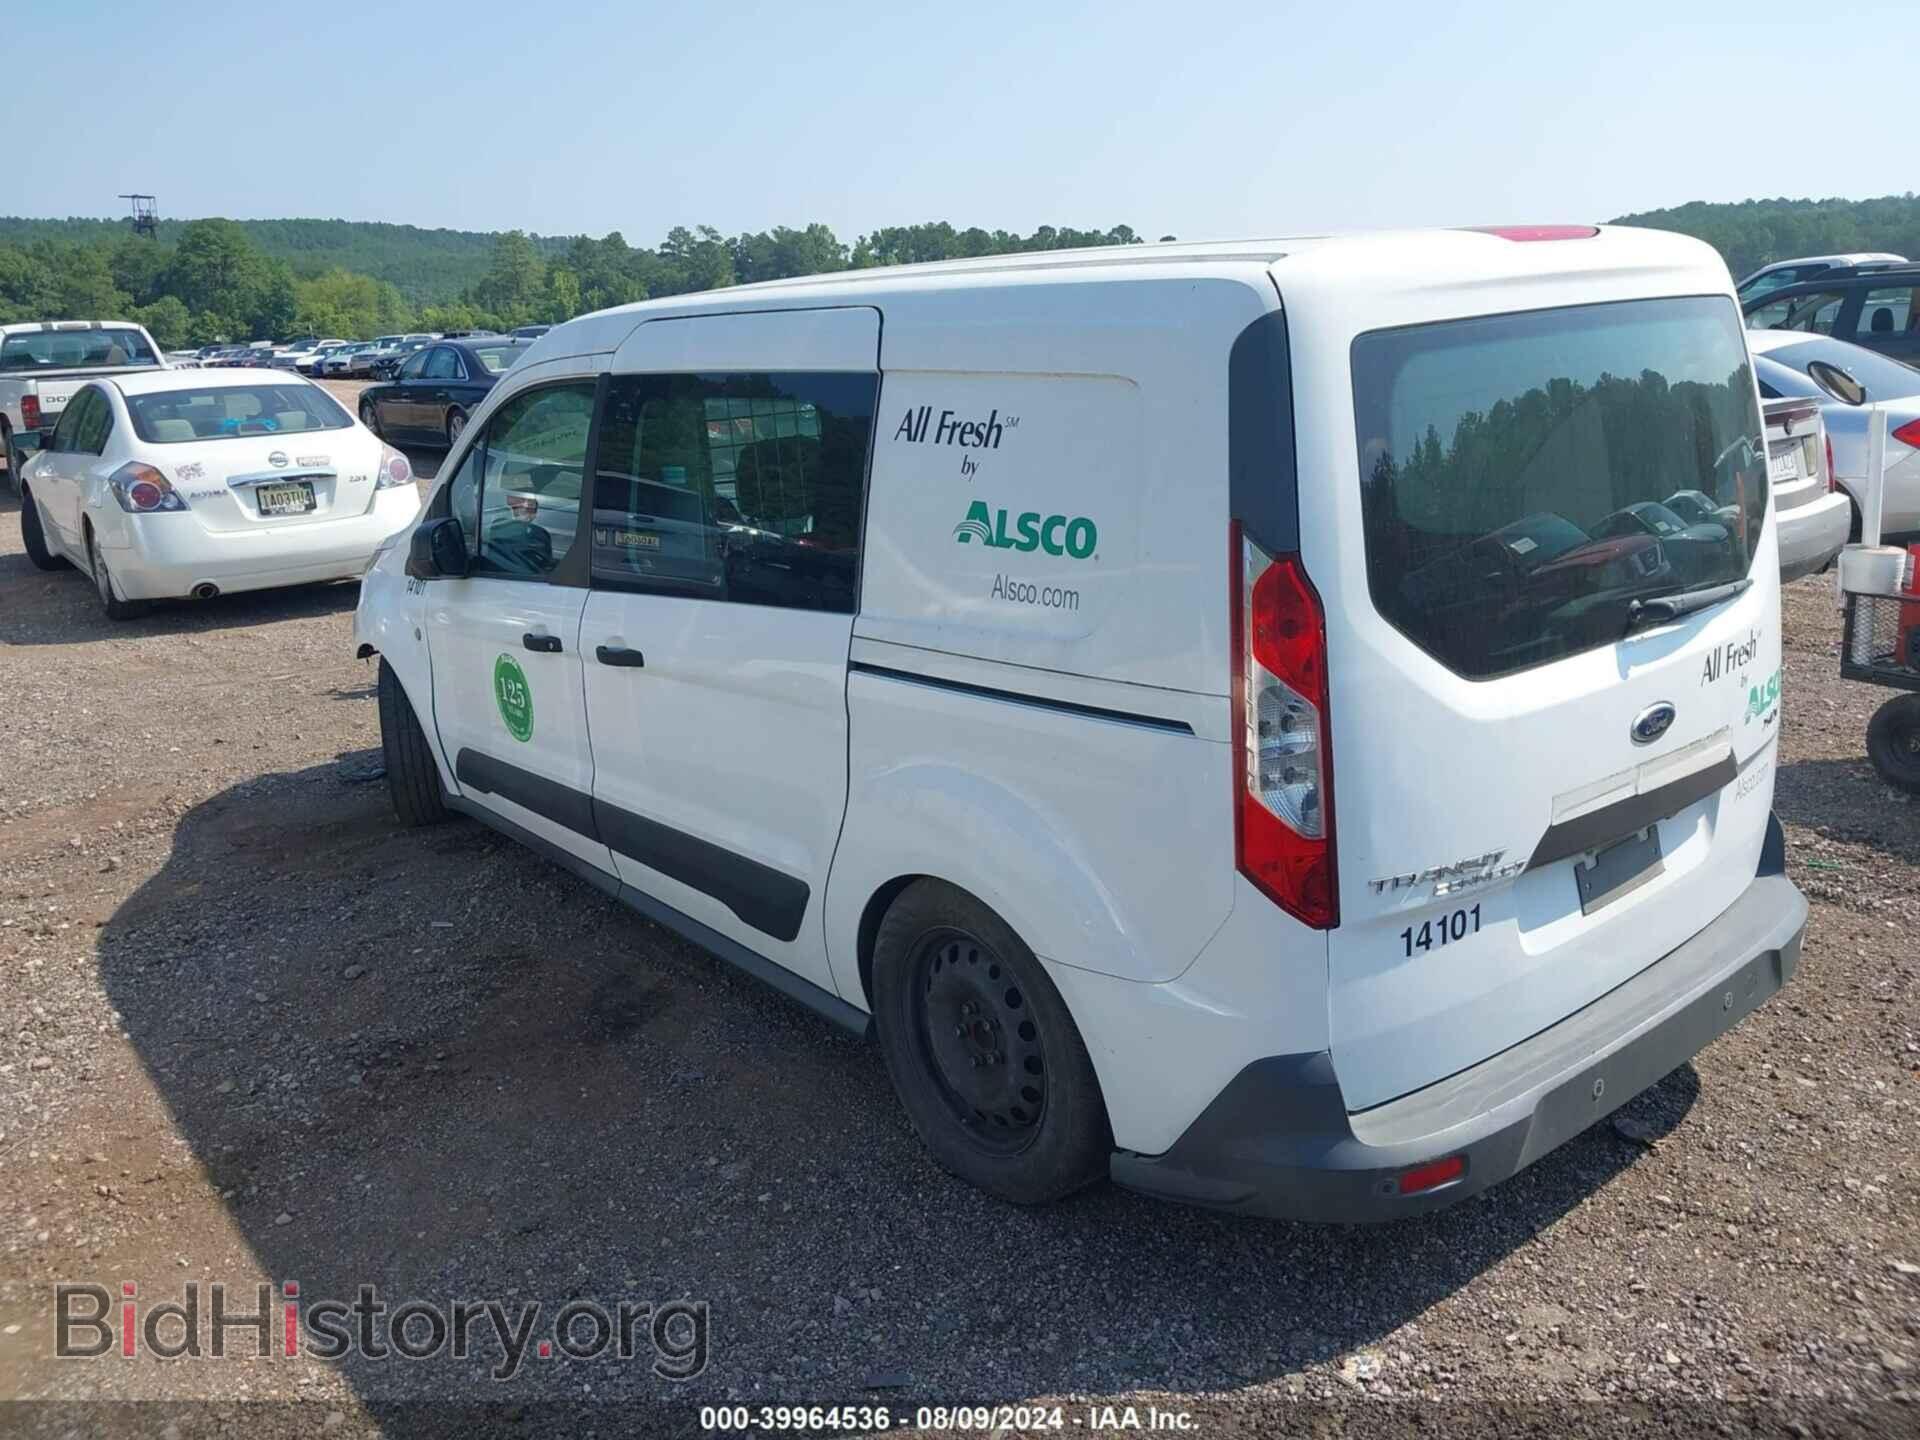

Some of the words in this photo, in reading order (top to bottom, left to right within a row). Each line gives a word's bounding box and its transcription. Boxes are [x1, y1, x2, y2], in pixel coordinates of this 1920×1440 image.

[894, 406, 932, 443] All
[935, 410, 1003, 449] Fresh
[961, 454, 979, 482] by
[953, 500, 1098, 560] ALSCO
[991, 573, 1080, 610] Alsco.com
[1701, 645, 1722, 688] All
[1726, 628, 1757, 675] Fresh
[500, 677, 526, 709] 125
[1367, 848, 1509, 896] TRANSIT
[1400, 902, 1481, 958] 14101
